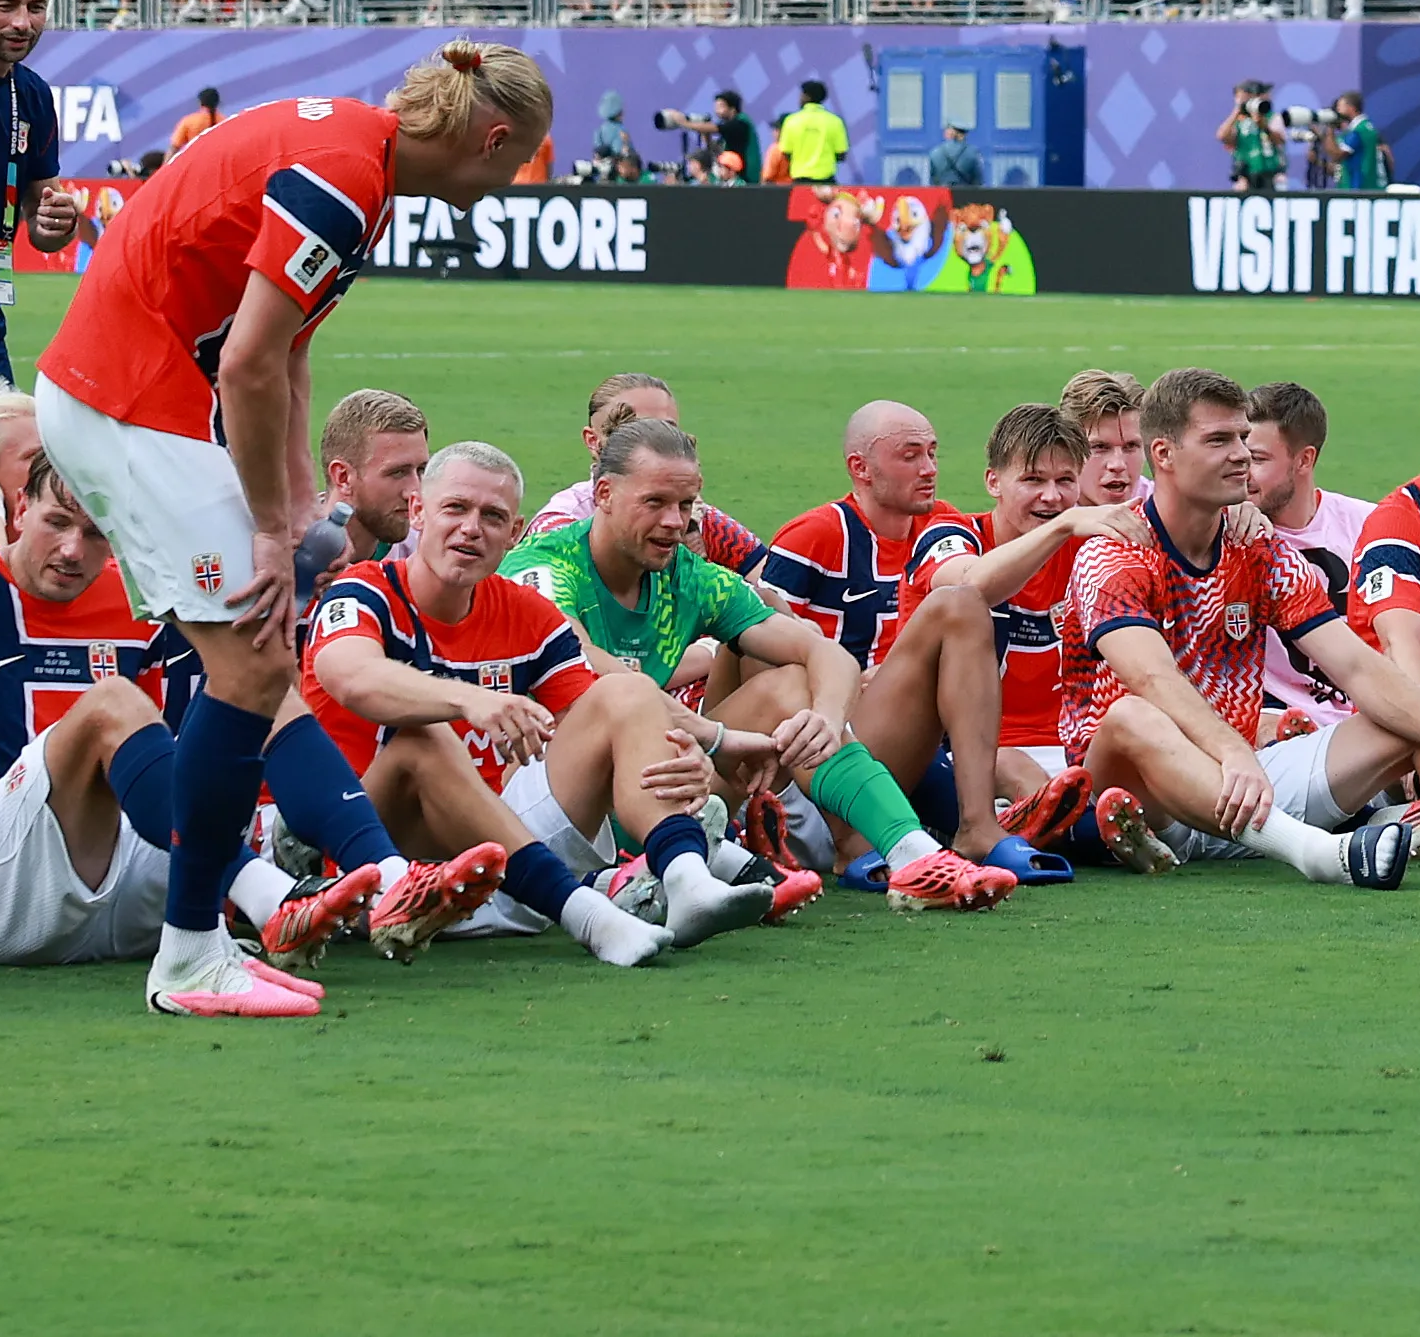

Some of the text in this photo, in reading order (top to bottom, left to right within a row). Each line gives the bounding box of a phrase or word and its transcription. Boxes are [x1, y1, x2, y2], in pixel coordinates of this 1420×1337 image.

[49, 85, 123, 142] FA
[472, 195, 648, 271] STORE
[1188, 196, 1322, 294] VISIT
